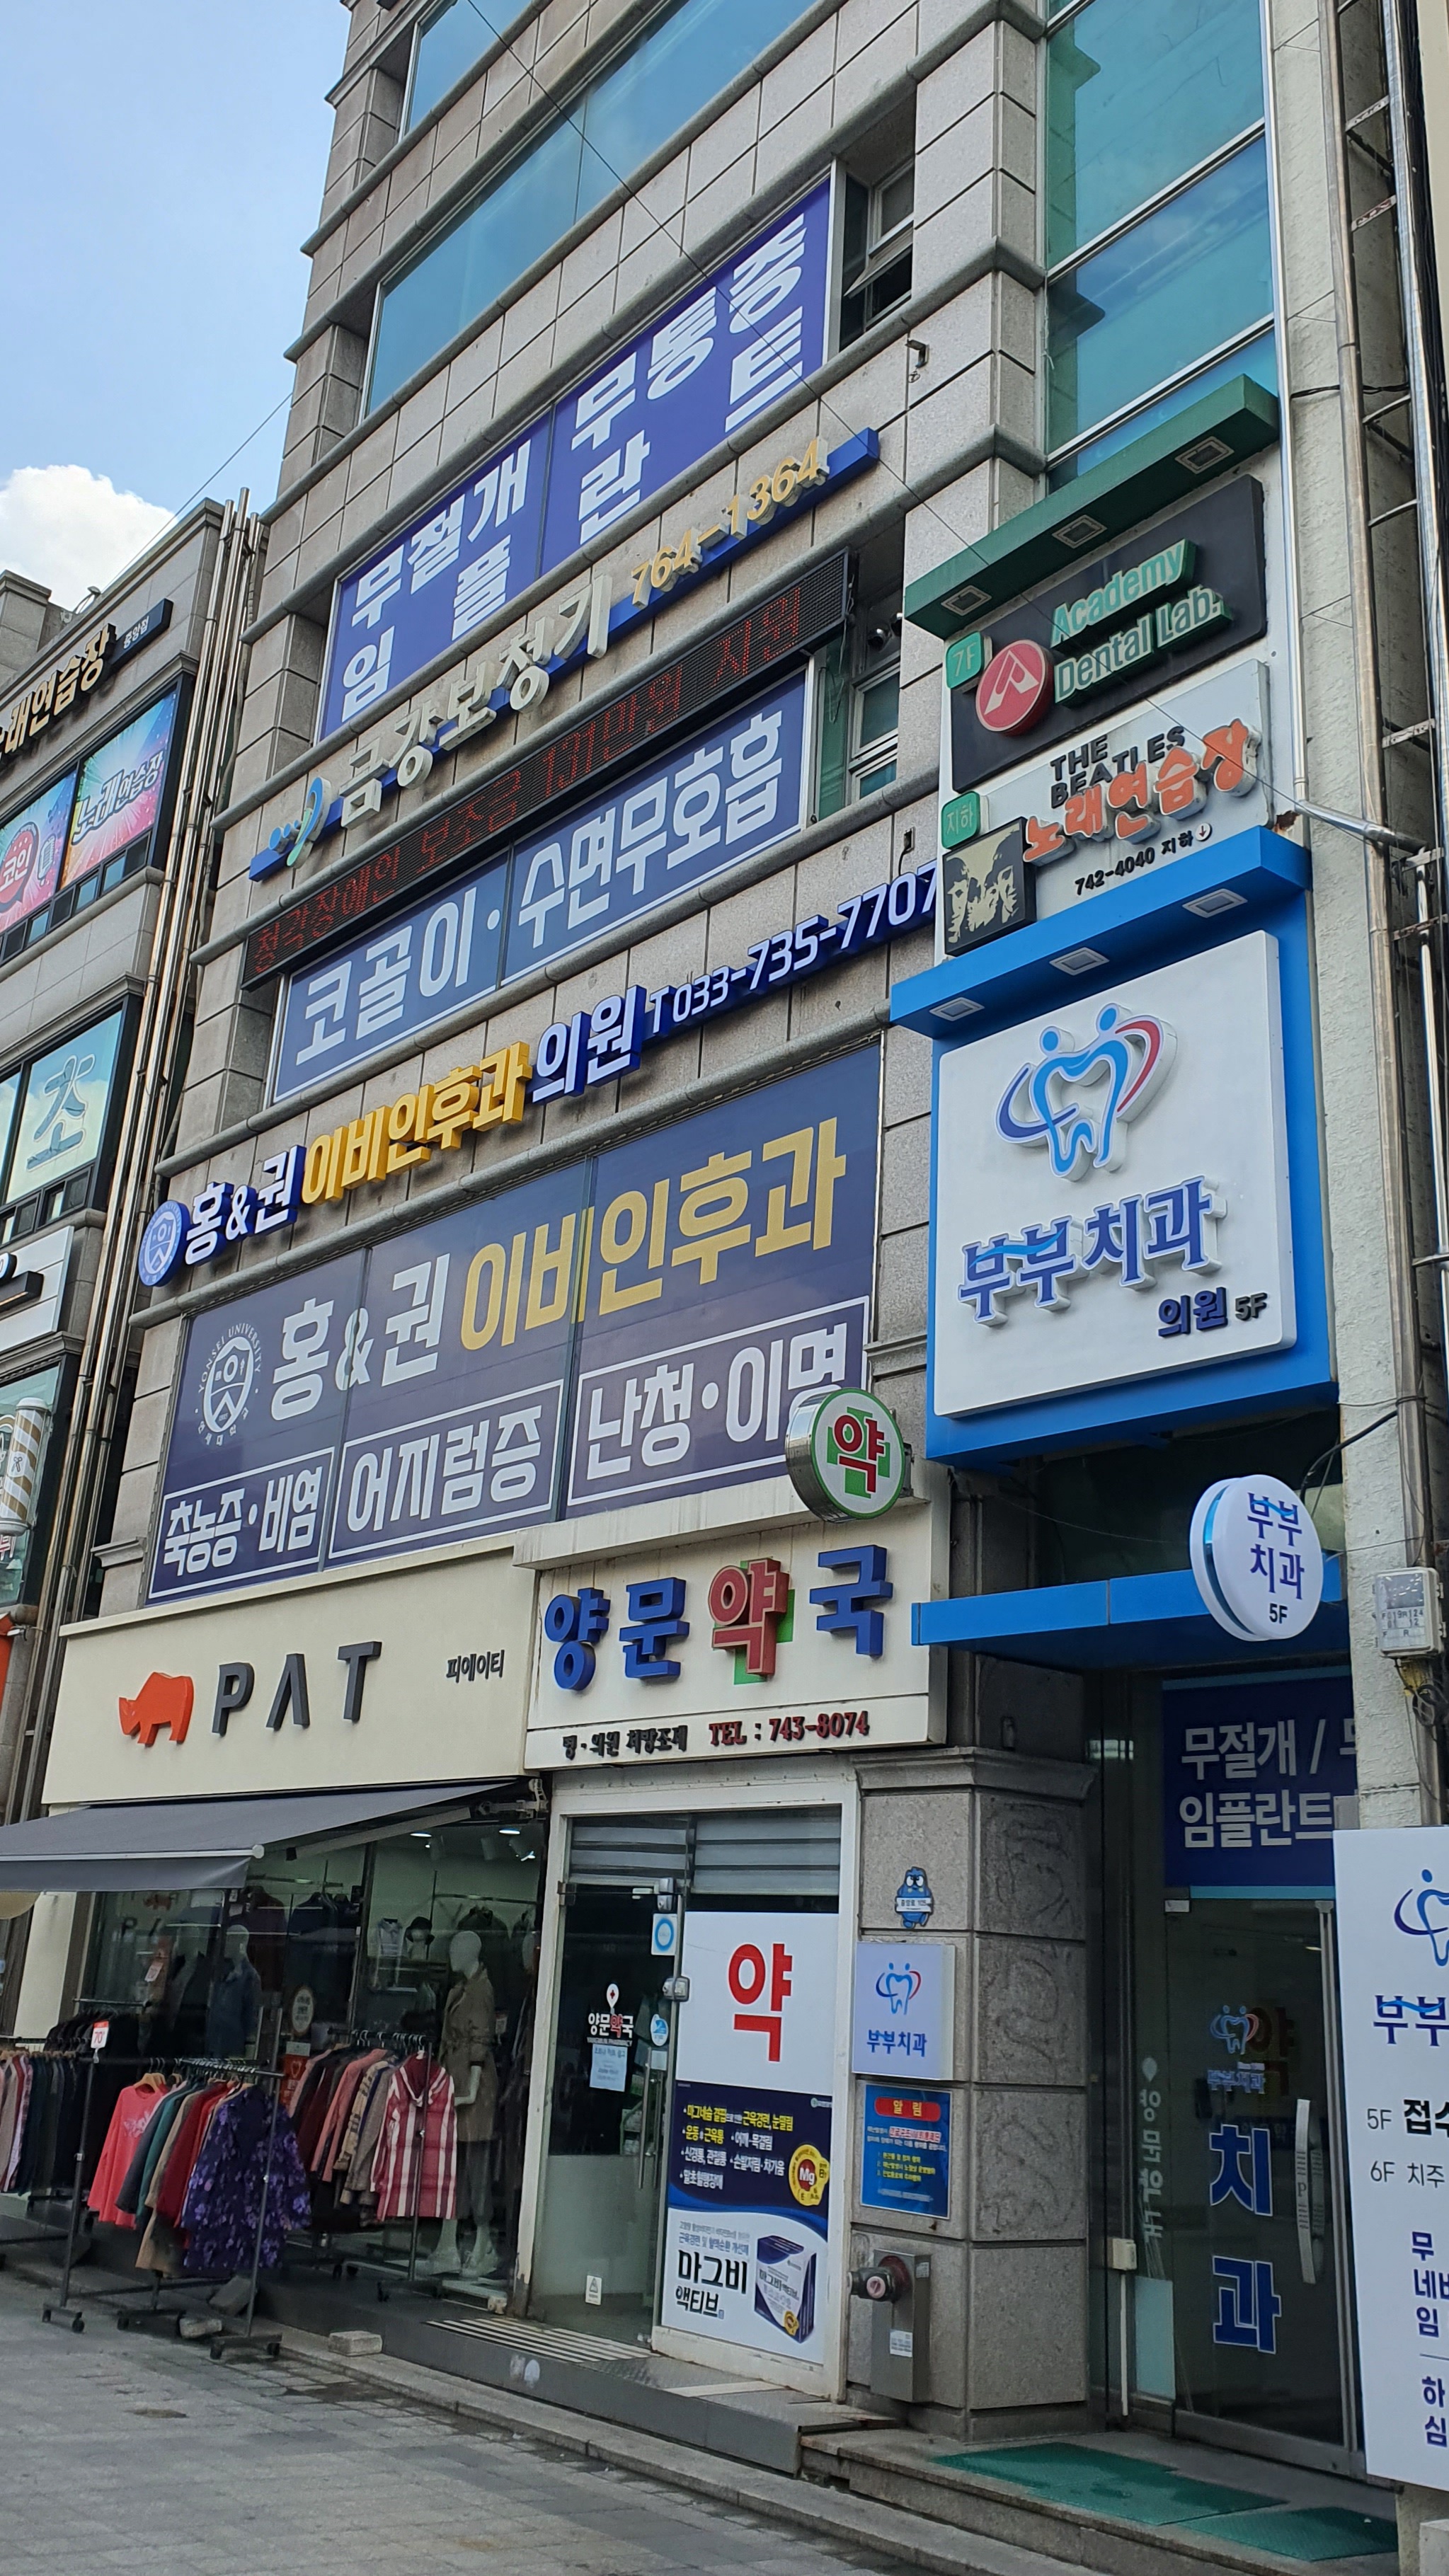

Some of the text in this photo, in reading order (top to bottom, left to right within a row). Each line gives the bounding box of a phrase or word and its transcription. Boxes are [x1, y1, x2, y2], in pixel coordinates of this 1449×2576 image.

[350, 214, 806, 629] 무절개 무통증
[342, 306, 802, 723] 임플란트
[1050, 539, 1193, 648] Academy
[340, 437, 829, 830] 금강보청기 764-1364
[952, 643, 975, 678] 7F
[1055, 585, 1226, 703] Dental Lab.
[0, 623, 110, 759] 래연습장
[255, 587, 801, 974] 청각장애인 보조금 131만원 지원
[1050, 734, 1109, 781] THE
[71, 752, 164, 845] 노래연습장
[946, 805, 975, 836] 지하
[1024, 718, 1253, 864] 노래연습장
[0, 844, 33, 892] 코인
[1075, 830, 1193, 895] 742-4040 지하
[185, 1144, 304, 1265] 홍&권
[302, 1042, 532, 1205] 이비인후과
[532, 985, 646, 1103] 의원
[270, 1116, 847, 1420] 홍&권 이비인후과
[958, 1175, 1213, 1323] 부부치과
[1158, 1287, 1268, 1338] 의원 5F
[197, 1322, 262, 1393] YONSEI UNIVERSITY
[347, 1405, 543, 1532] 어지럼증
[833, 1413, 886, 1494] 약
[1247, 1491, 1303, 1548] 부부
[1250, 1543, 1305, 1600] 치과
[544, 1543, 894, 1692] 양문약국
[1268, 1602, 1288, 1625] 5F
[446, 1649, 505, 1684] 피에이티
[626, 1725, 689, 1754] 처방조제
[708, 1720, 748, 1747] TEL
[768, 1710, 871, 1742] 743-8074
[1181, 1718, 1298, 1781] 무절개
[1179, 1789, 1333, 1848] 임플란트
[588, 2012, 634, 2038] 양문약국
[728, 1943, 793, 2062] 약
[867, 2028, 928, 2058] 부부치과
[704, 2127, 724, 2144] 근육통
[1366, 2108, 1393, 2130] 5F
[799, 2167, 815, 2186] Mg
[1370, 2160, 1446, 2189] 6F 치주
[1209, 2124, 1281, 2354] 치과
[675, 2285, 720, 2318] 액티브
[678, 2249, 748, 2295] 마그비
[1416, 2306, 1440, 2338] 임
[1421, 2376, 1446, 2408] 하
